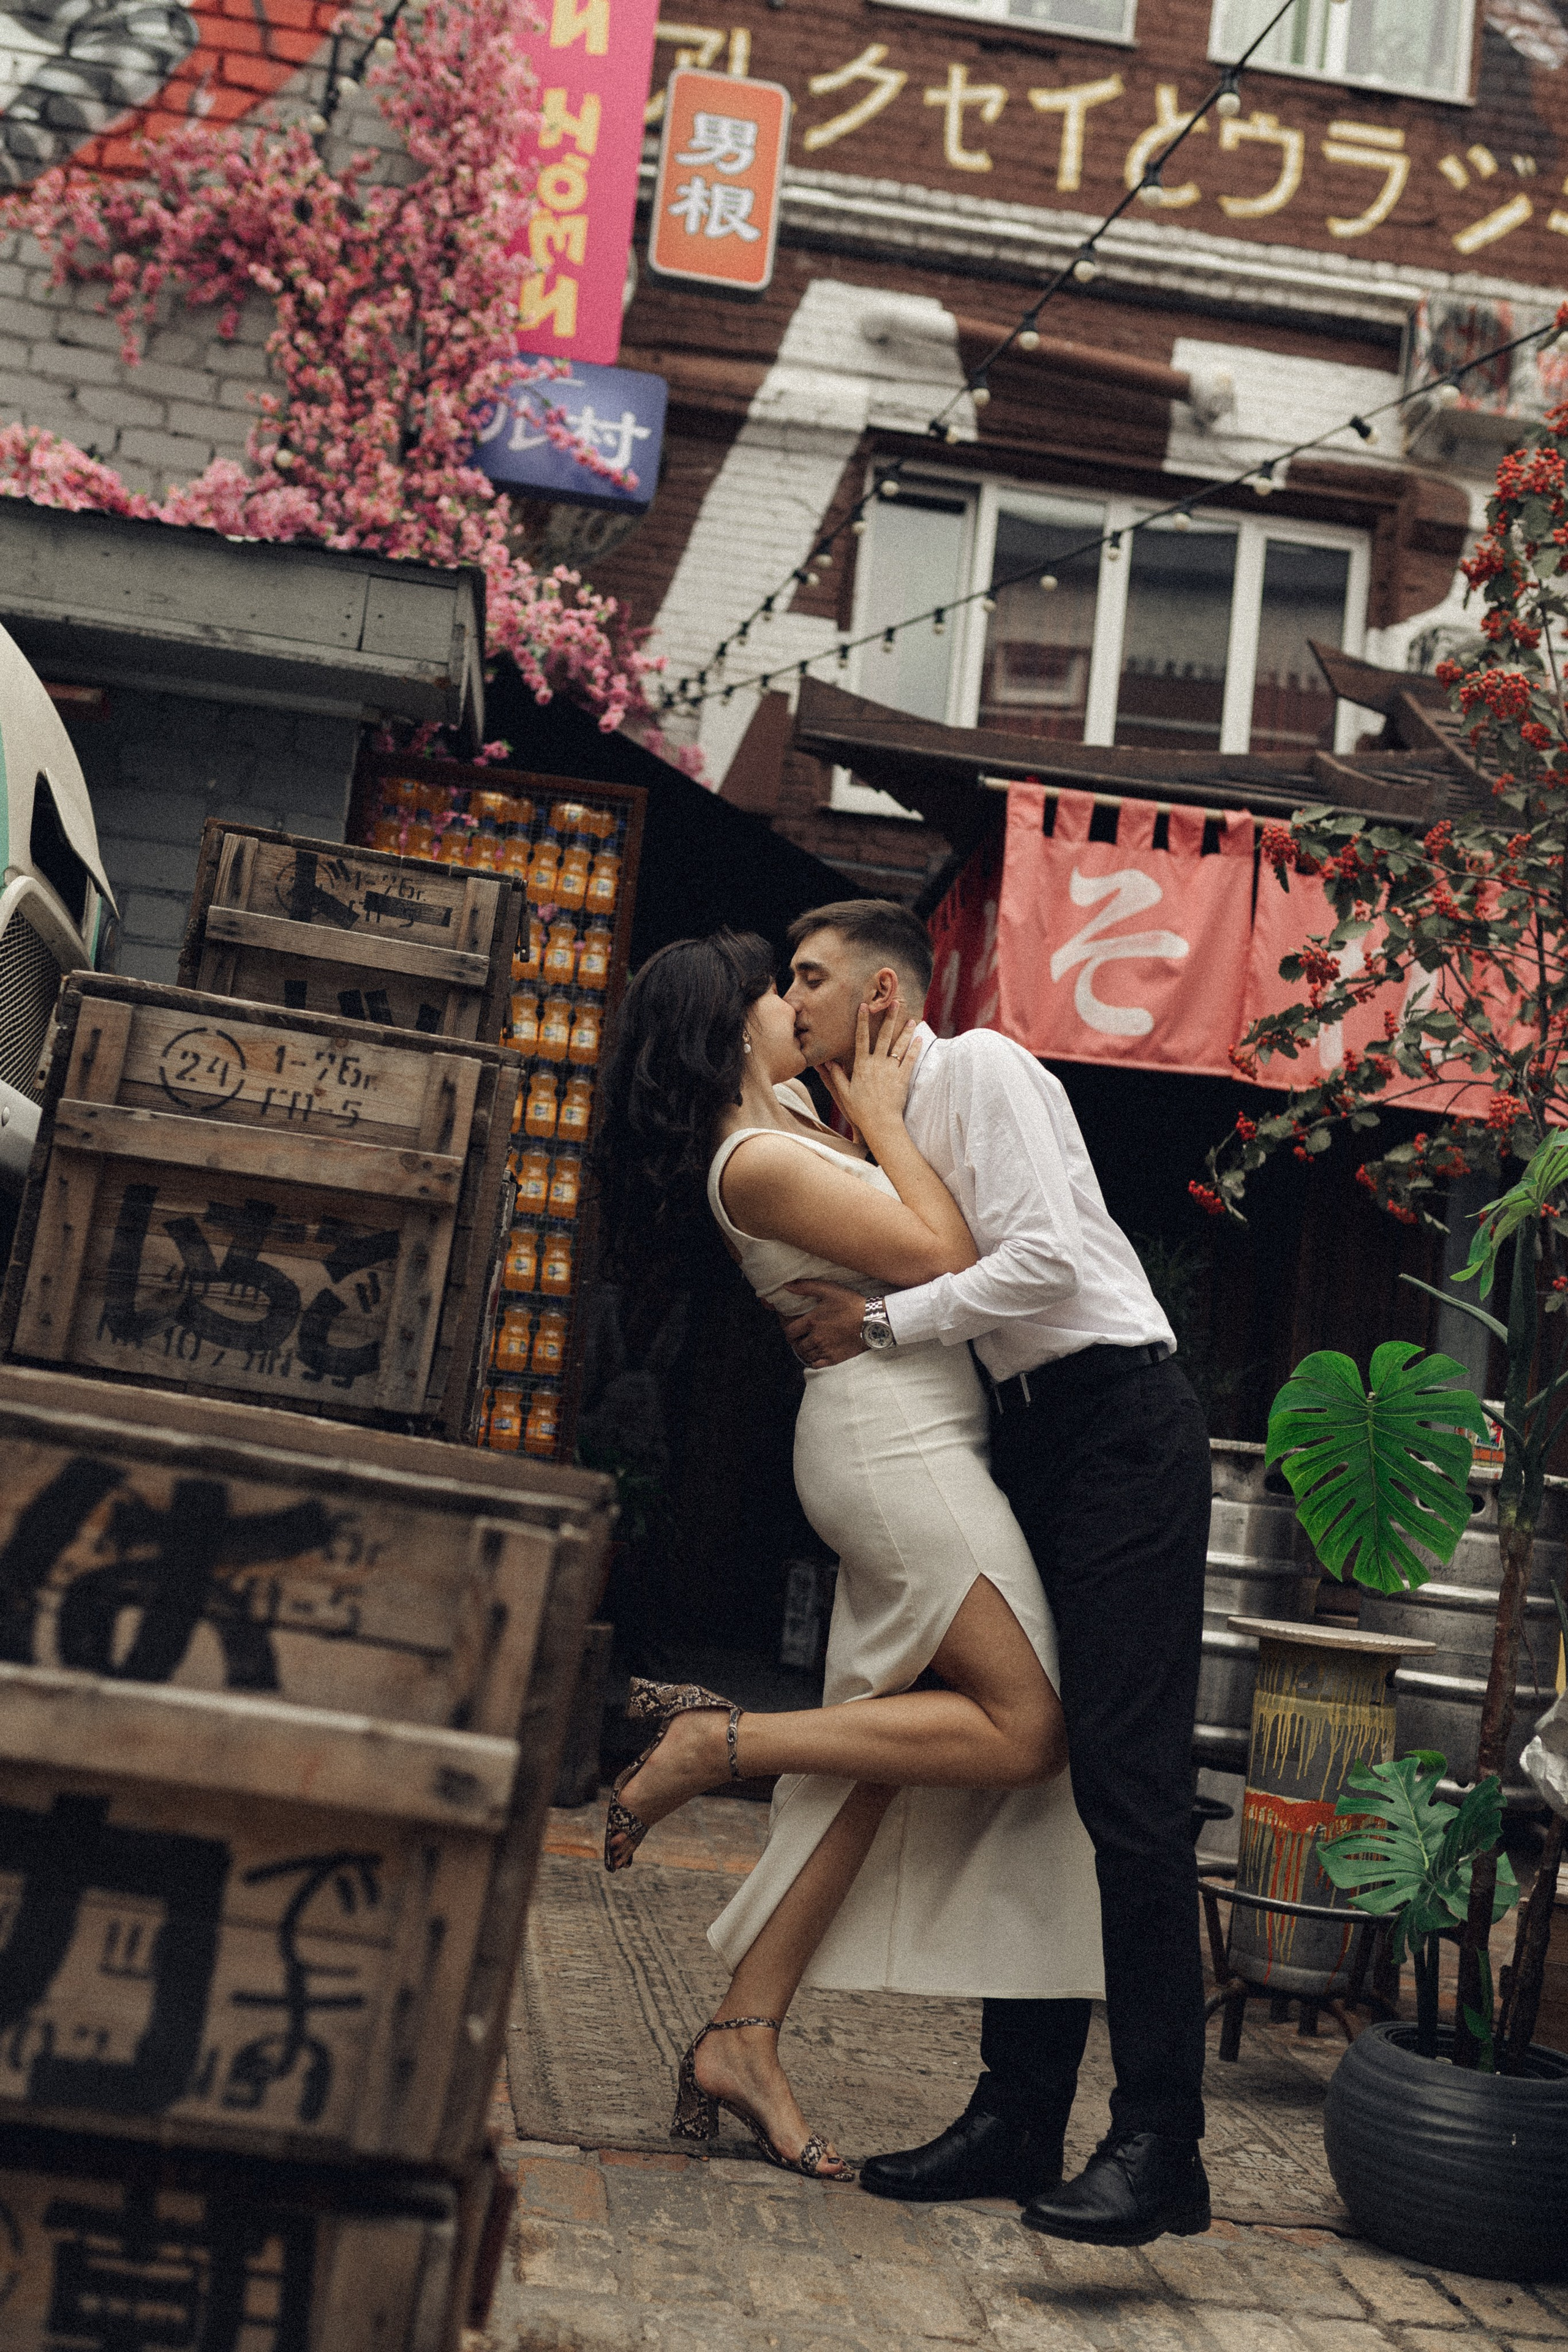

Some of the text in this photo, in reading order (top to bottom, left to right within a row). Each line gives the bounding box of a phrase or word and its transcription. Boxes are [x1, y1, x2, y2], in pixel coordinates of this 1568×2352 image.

[667, 111, 762, 243] 男根
[1050, 865, 1189, 1037] そ
[175, 1049, 229, 1088] 24
